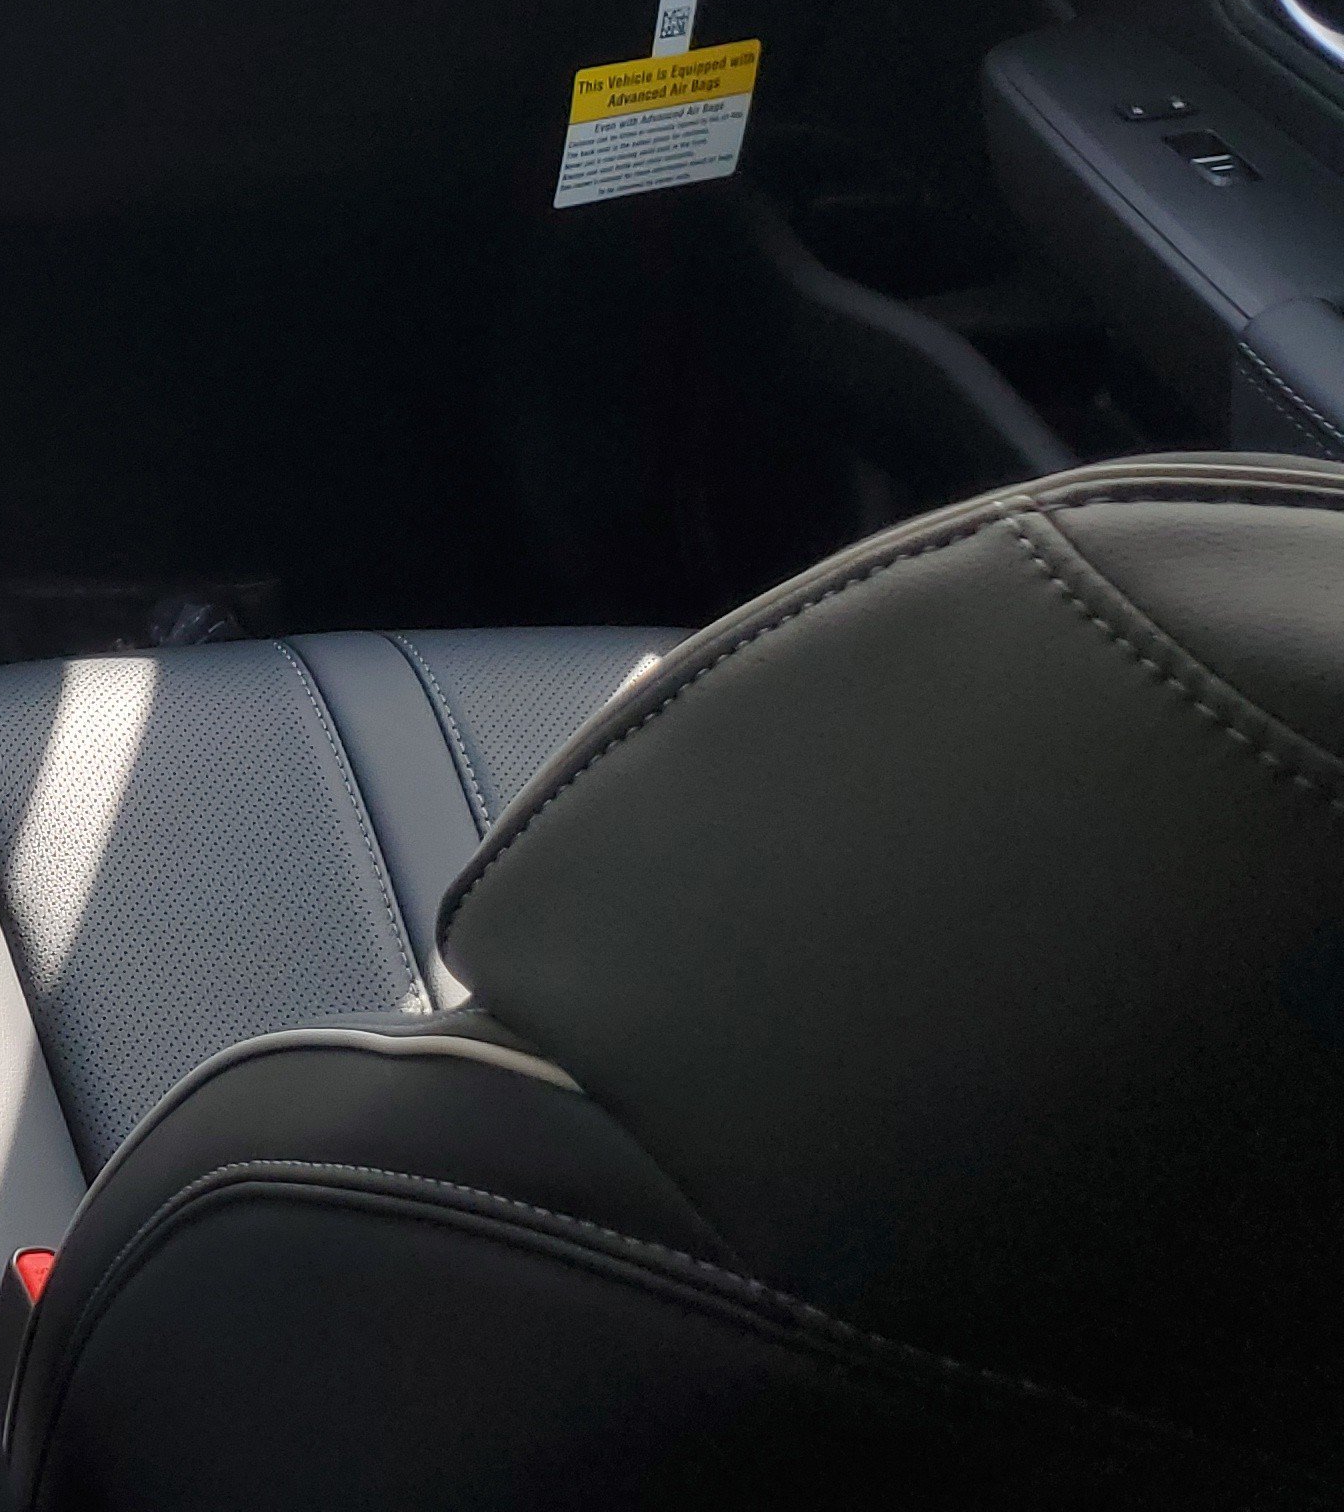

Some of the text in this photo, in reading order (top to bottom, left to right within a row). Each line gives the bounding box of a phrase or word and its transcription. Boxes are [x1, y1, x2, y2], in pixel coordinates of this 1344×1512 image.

[578, 79, 604, 95] This
[607, 71, 654, 90] Vehicle
[670, 55, 728, 79] Equipped
[607, 77, 721, 108] Advanced Air Bags
[594, 121, 616, 133] Even
